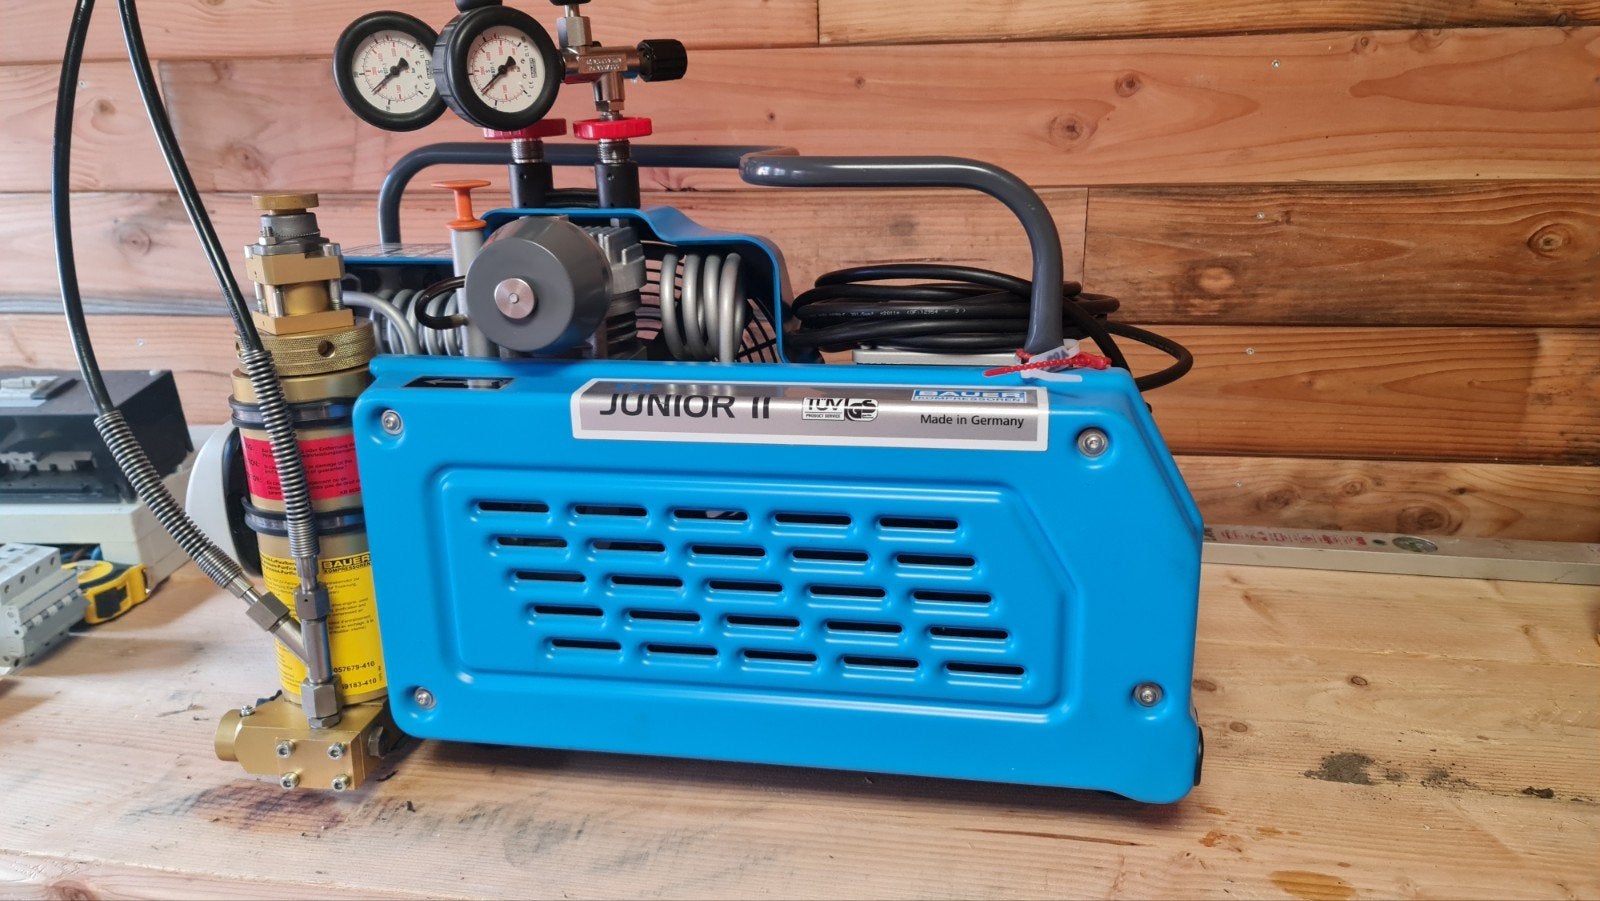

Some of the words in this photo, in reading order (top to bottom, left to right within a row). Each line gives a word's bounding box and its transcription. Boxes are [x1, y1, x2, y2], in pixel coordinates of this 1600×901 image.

[918, 389, 1021, 399] BAUER
[600, 393, 735, 419] JUNIOR
[751, 396, 771, 419] II
[808, 398, 844, 411] TÜV
[920, 414, 953, 425] Made
[957, 415, 967, 425] in
[971, 415, 1024, 429] Germany
[324, 554, 370, 569] BAUER
